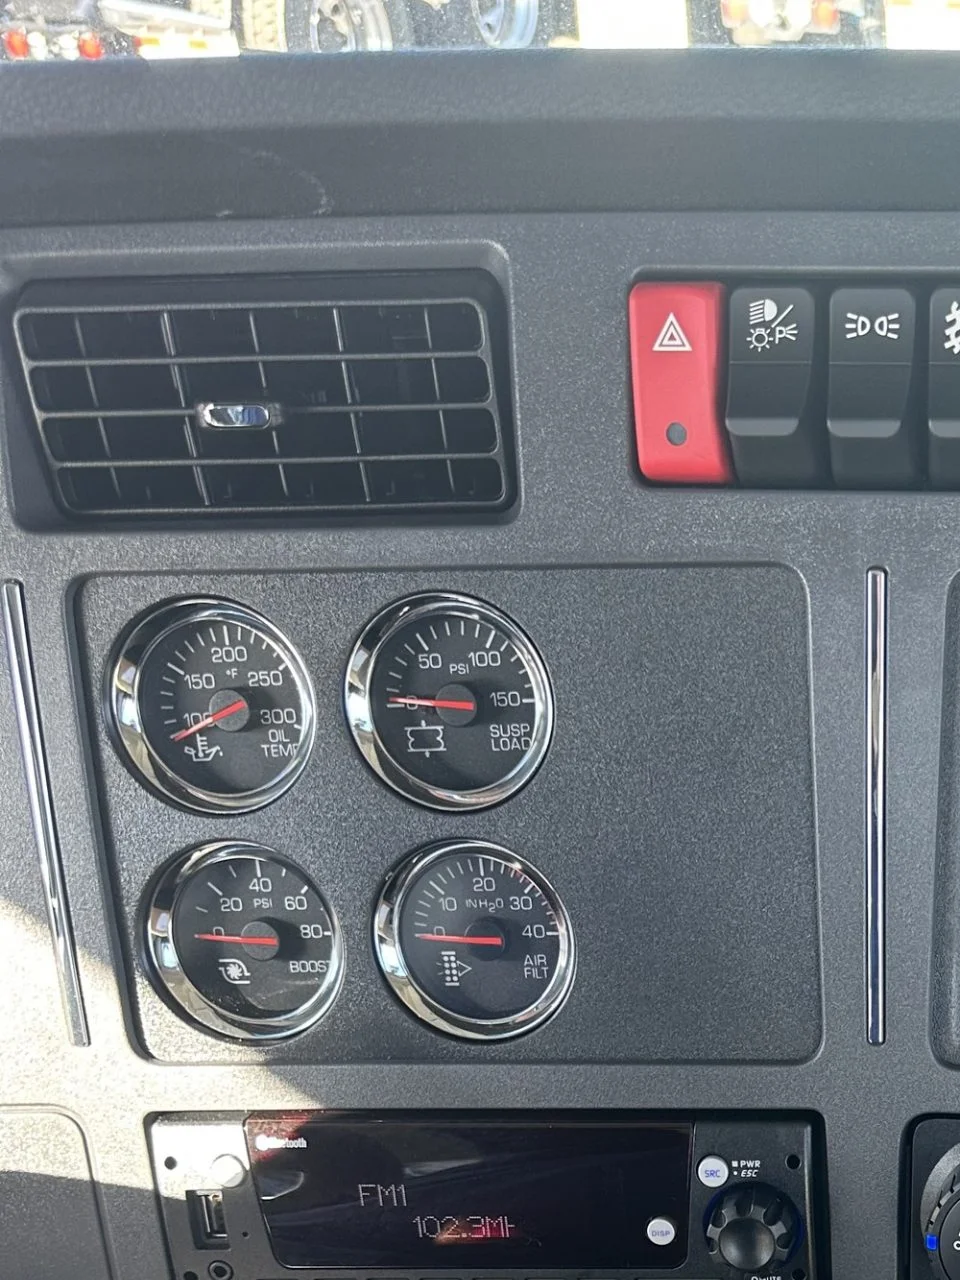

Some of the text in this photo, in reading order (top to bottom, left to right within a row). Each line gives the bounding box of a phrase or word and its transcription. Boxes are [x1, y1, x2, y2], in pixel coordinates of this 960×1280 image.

[211, 646, 247, 662] 200
[418, 653, 442, 669] 50
[468, 651, 501, 667] 100
[449, 663, 469, 675] PSI
[184, 673, 215, 689] 150
[248, 671, 283, 687] 250
[490, 691, 521, 707] 150
[260, 708, 296, 724] 300
[268, 729, 290, 742] OIL
[489, 724, 531, 738] SUSP
[491, 738, 532, 751] LOAD
[249, 878, 272, 893] 40
[473, 877, 496, 892] 20
[220, 897, 243, 912] 20
[254, 899, 273, 908] PSI
[284, 896, 307, 911] 60
[440, 897, 458, 912] 10
[510, 896, 533, 911] 30
[300, 924, 323, 939] 80
[522, 924, 546, 939] 40
[524, 954, 547, 966] AIR
[524, 967, 549, 979] FILT
[740, 1160, 761, 1168] PWR
[704, 1169, 721, 1178] SRC
[740, 1169, 759, 1178] ESC
[358, 1184, 407, 1207] FM1
